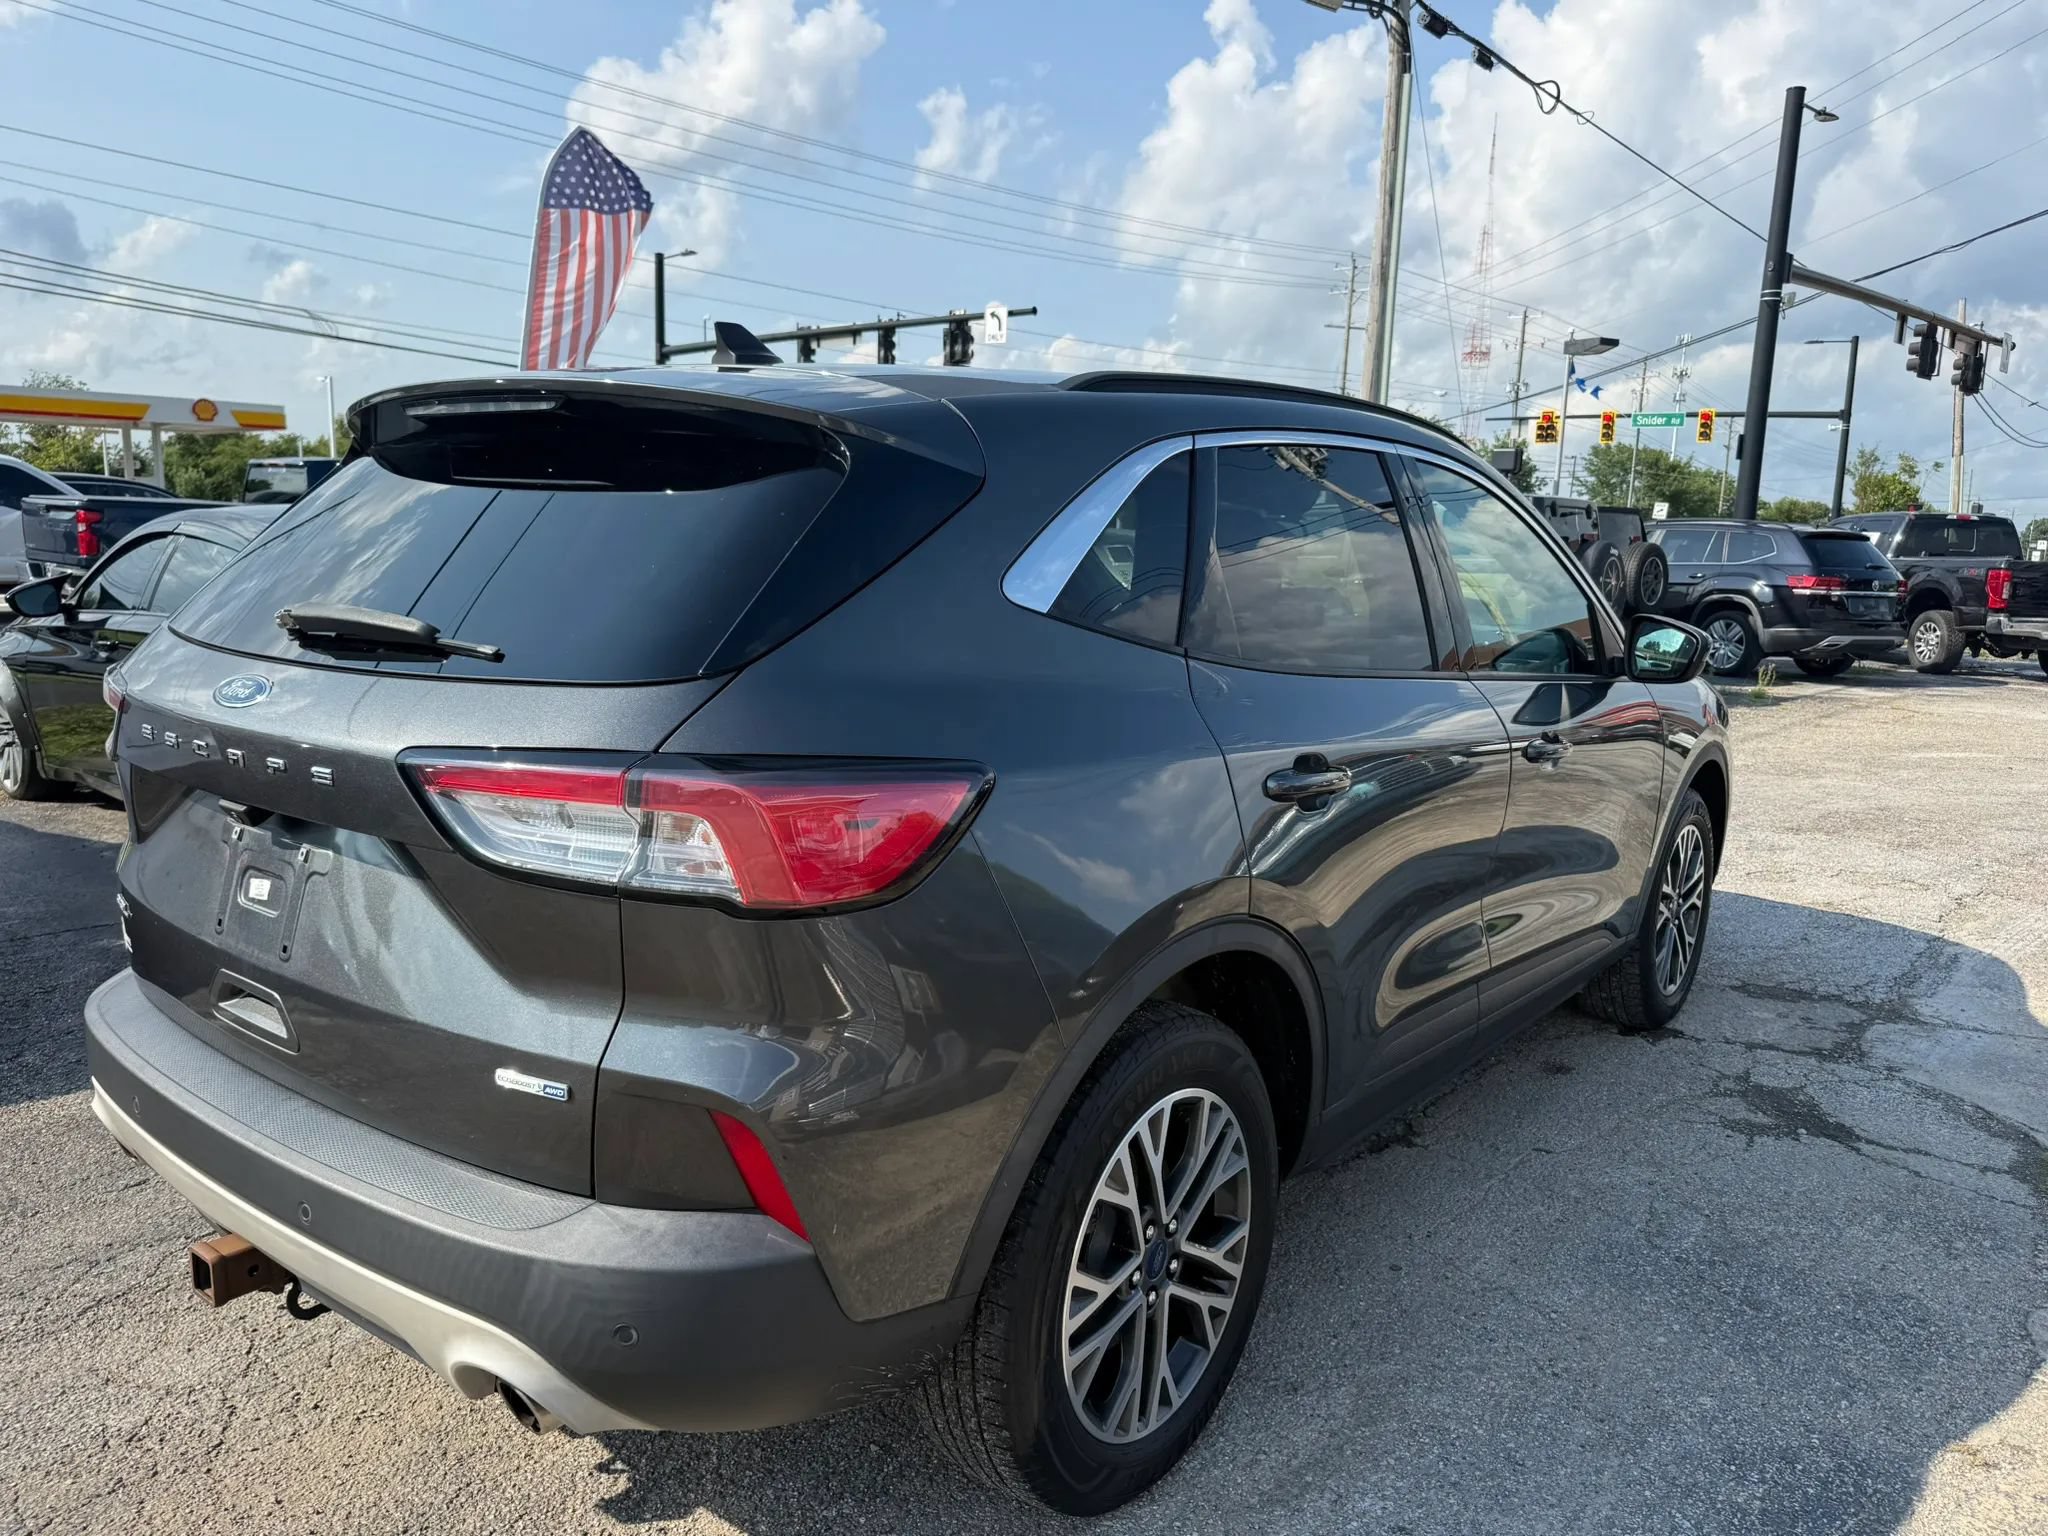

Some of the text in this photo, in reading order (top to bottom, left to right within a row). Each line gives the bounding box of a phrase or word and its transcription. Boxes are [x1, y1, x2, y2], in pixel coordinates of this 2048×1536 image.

[987, 333, 1004, 342] ONLY
[1636, 415, 1681, 425] Snider Rd
[221, 678, 256, 699] Ford
[141, 723, 335, 787] ESCAPE
[544, 1086, 564, 1097] AWD
